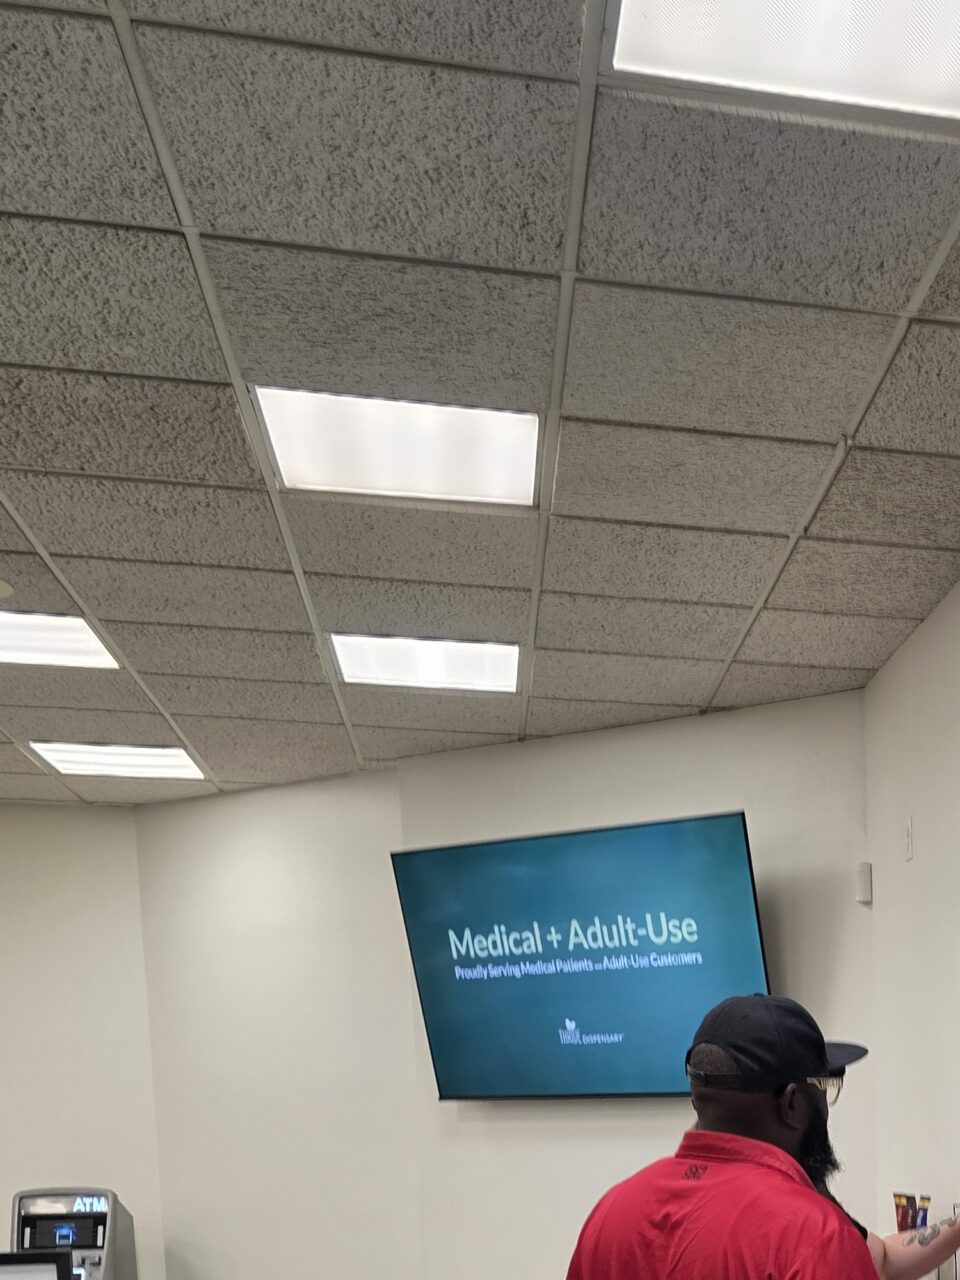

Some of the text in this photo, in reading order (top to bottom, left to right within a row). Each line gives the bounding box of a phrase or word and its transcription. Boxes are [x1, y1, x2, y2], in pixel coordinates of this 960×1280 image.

[448, 911, 699, 961] Medical + Adult-Use
[455, 964, 488, 981] Proudly
[488, 962, 521, 979] Serving
[521, 958, 556, 976] Medical
[556, 957, 593, 974] Patients
[603, 953, 650, 970] Adult-Use
[650, 951, 703, 966] Customers
[73, 1196, 108, 1213] ATM
